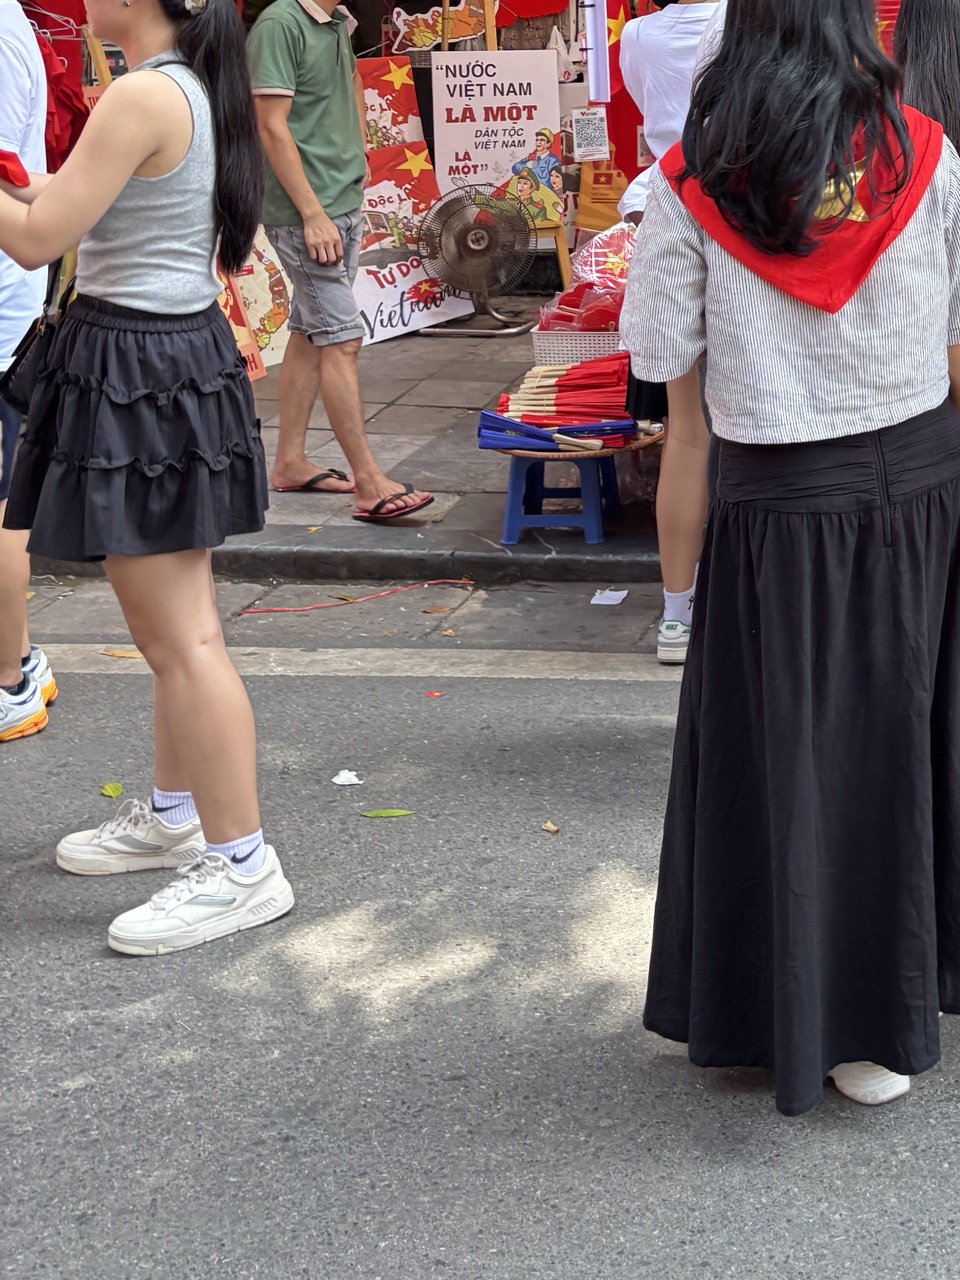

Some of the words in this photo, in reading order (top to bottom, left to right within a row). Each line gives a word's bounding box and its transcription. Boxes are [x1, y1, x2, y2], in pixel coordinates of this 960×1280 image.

[446, 80, 487, 101] VIỆT
[493, 82, 533, 97] NAM
[445, 103, 477, 124] LÀ
[483, 102, 538, 125] MỘT
[474, 127, 498, 138] DÂN
[502, 125, 525, 139] TỘC
[474, 138, 499, 151] VIỆT
[501, 139, 526, 149] NAM
[455, 148, 472, 163] LÀ
